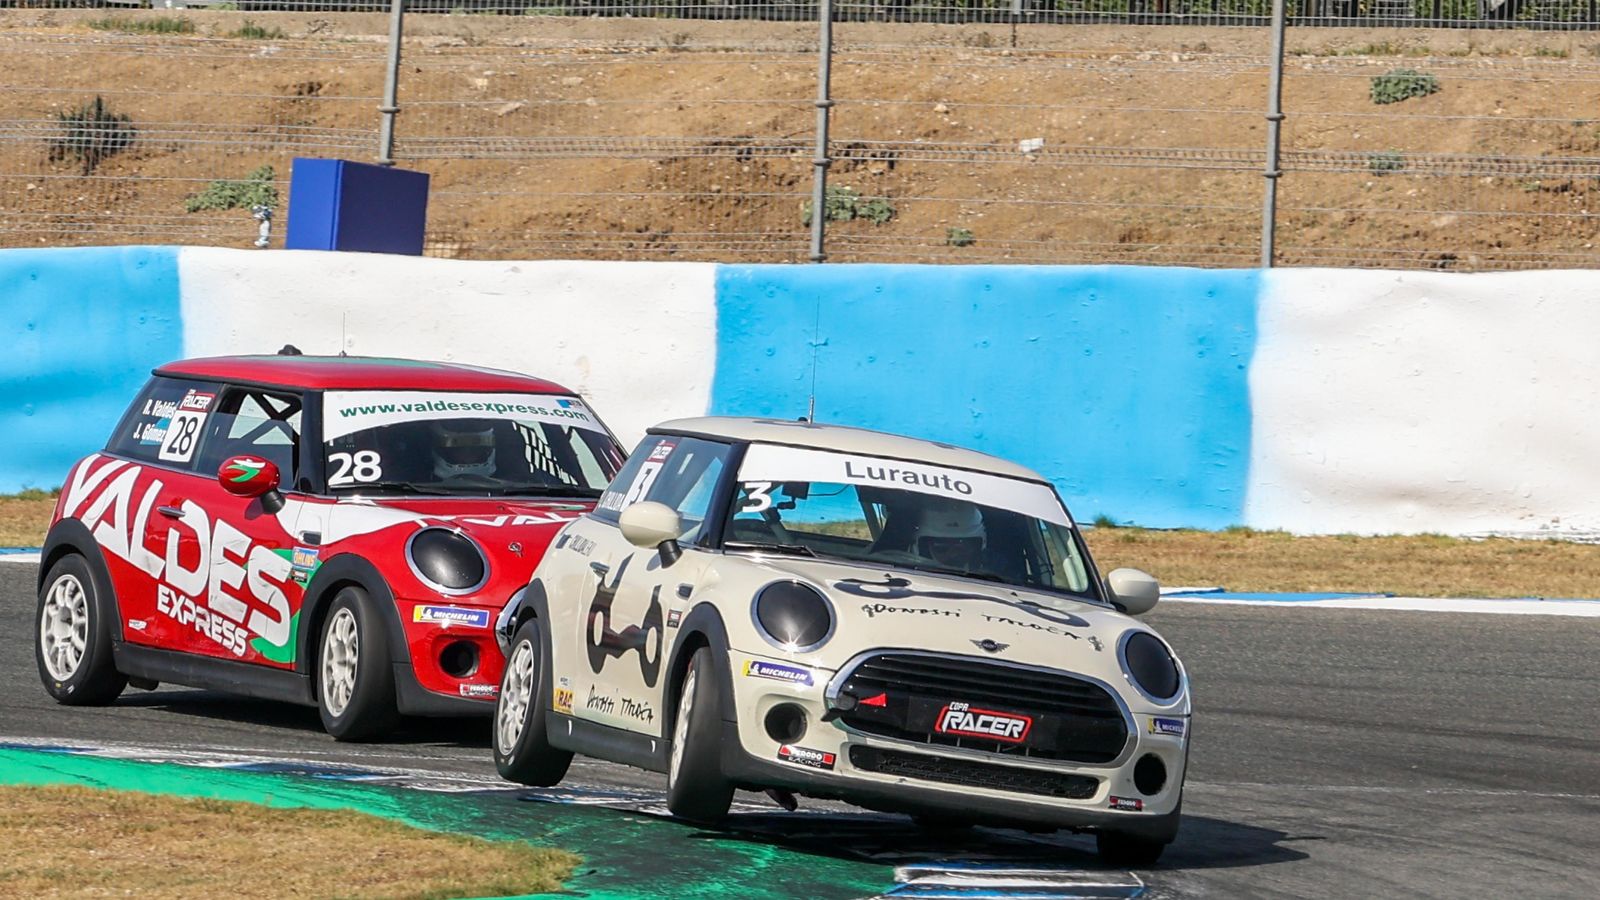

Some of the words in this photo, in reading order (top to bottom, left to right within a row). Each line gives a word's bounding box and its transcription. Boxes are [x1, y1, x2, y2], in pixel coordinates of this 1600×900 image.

[339, 399, 590, 423] www.valdesexpress.com
[166, 415, 199, 456] 28
[327, 450, 382, 485] 28
[844, 460, 973, 496] Lurauto
[741, 481, 773, 513] 3
[63, 453, 294, 648] VALDES
[156, 584, 249, 657] EXPRESS
[433, 610, 480, 622] MICHELIN
[760, 667, 809, 681] MICHELIN
[941, 710, 1026, 739] RACER
